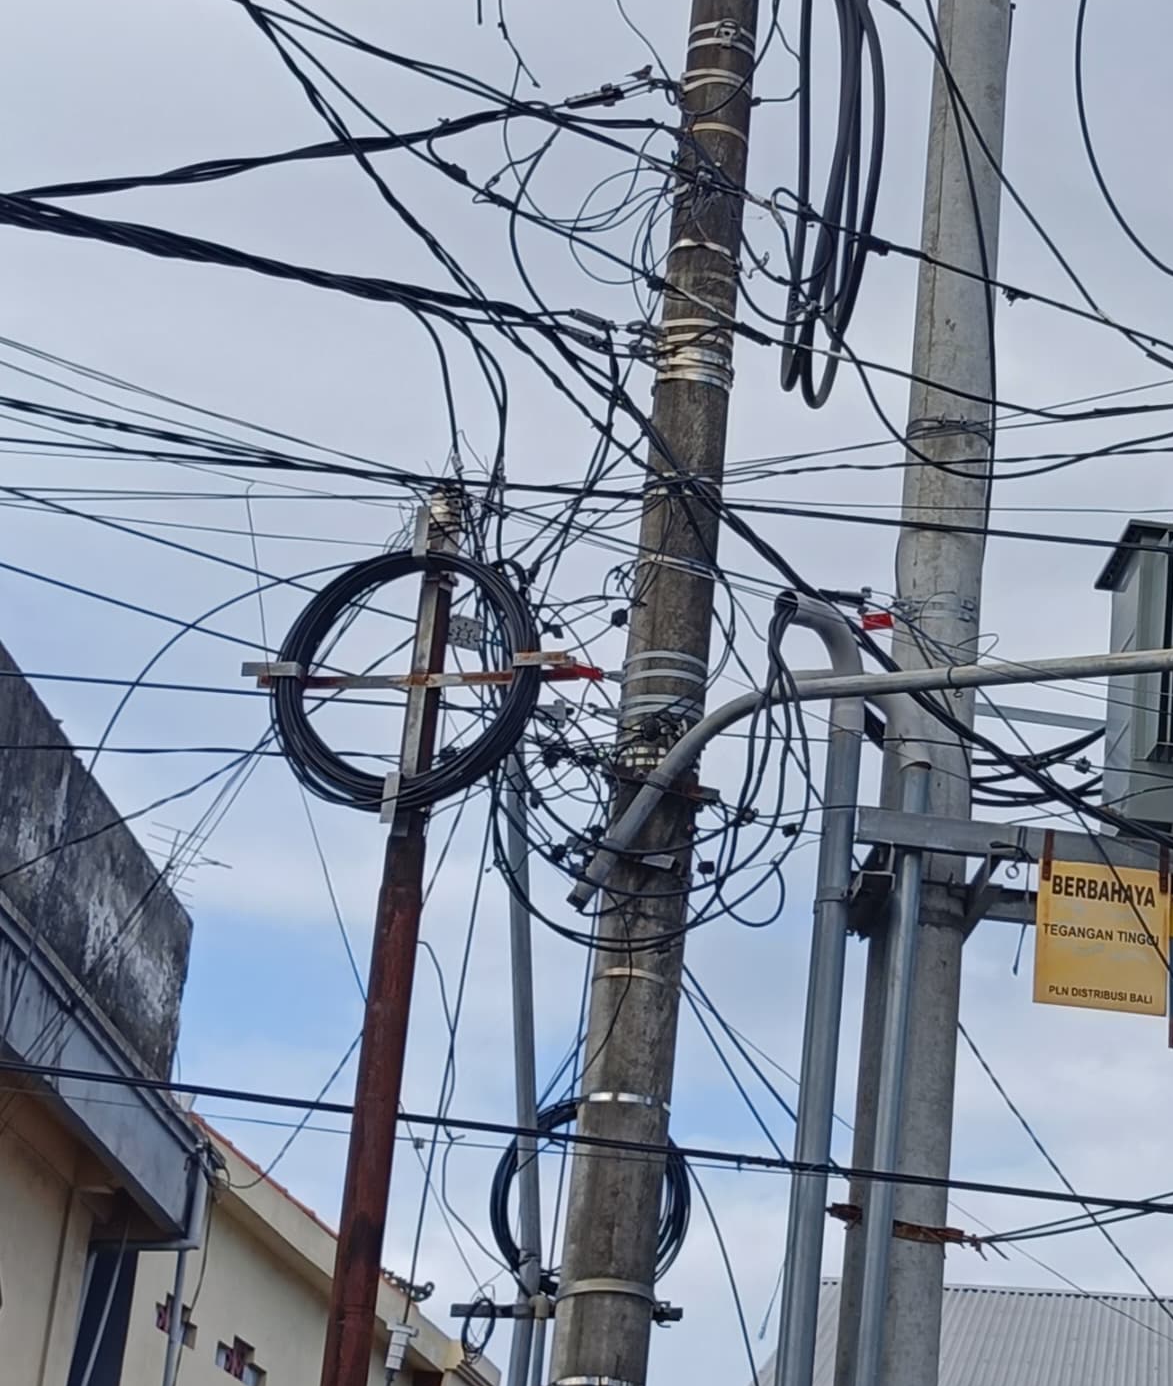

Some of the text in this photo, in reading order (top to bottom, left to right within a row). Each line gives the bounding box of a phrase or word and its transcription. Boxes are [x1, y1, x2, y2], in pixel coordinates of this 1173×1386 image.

[1051, 875, 1156, 908] BERBAHAYA
[1043, 923, 1159, 947] TEGANGAN TINGGI
[1048, 985, 1153, 1004] PLN DISTRIBUSI BALI
